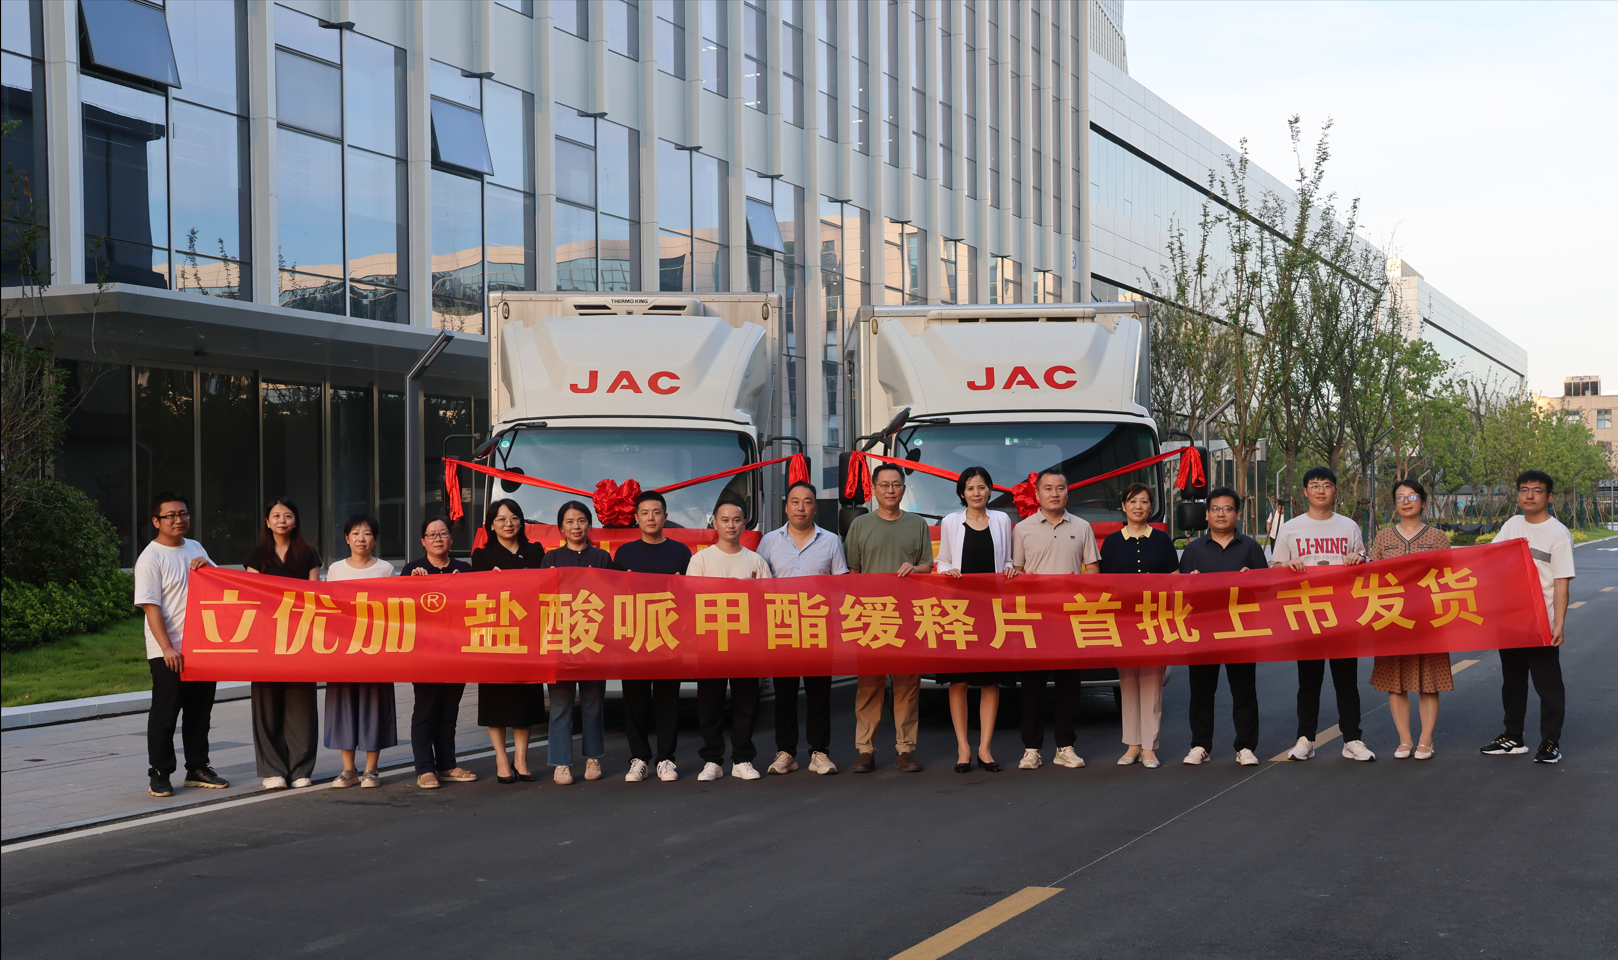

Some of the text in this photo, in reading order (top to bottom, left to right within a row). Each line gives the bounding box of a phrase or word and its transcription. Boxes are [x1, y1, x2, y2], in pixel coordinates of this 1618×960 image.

[569, 370, 681, 395] JAC
[967, 365, 1078, 391] JAC
[1296, 537, 1348, 557] LI-NING
